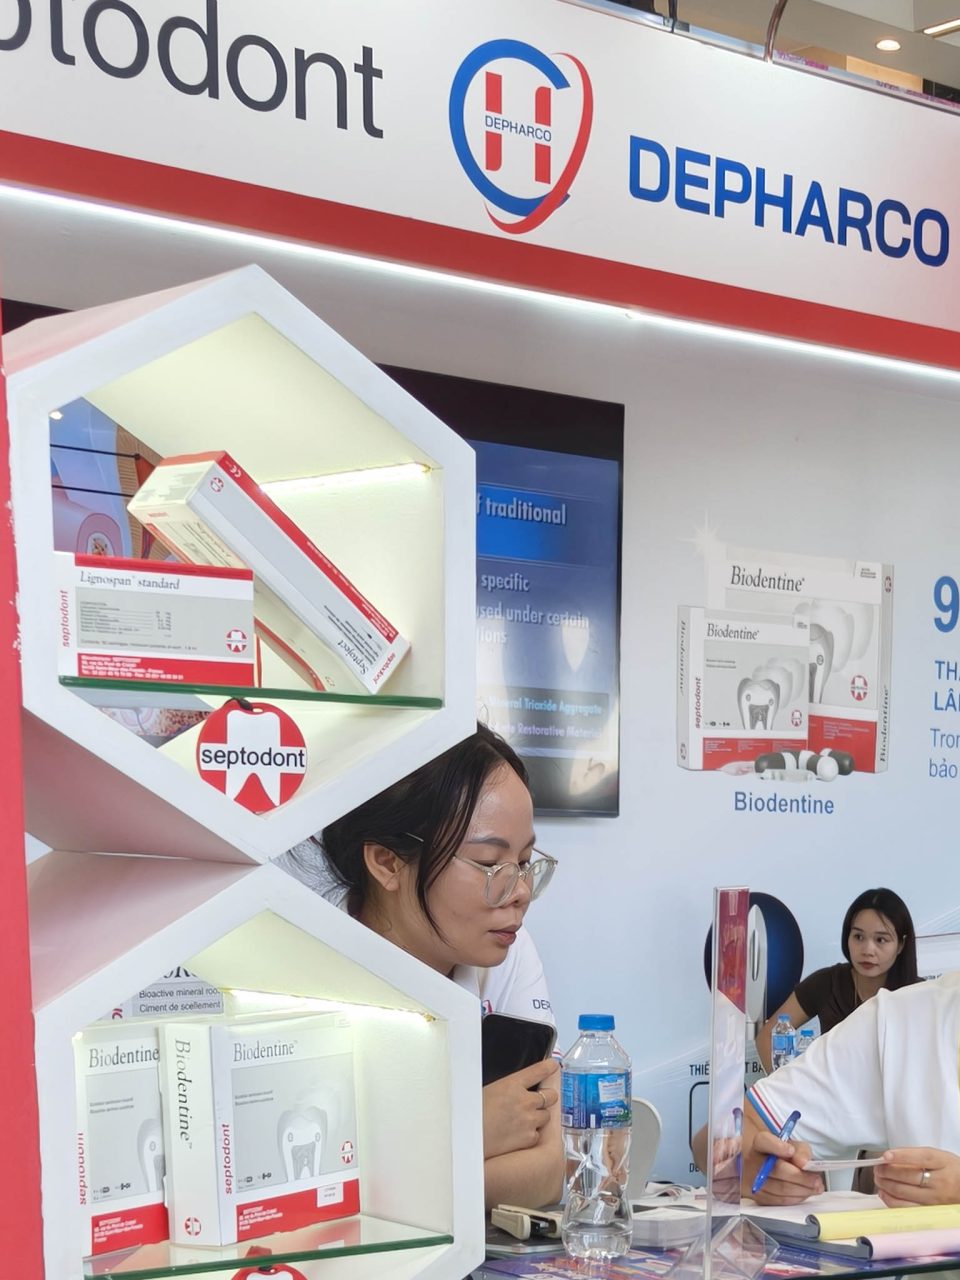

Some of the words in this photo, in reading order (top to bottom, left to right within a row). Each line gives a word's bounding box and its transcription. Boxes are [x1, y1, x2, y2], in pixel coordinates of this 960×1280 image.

[485, 115, 552, 142] DEPHARCO
[629, 135, 950, 267] DEPHARCO
[487, 497, 567, 525] traditional
[80, 571, 132, 588] Lignospan
[138, 577, 181, 590] standard
[481, 573, 530, 591] specific
[730, 565, 803, 592] Biodentine
[60, 590, 70, 648] septodont
[507, 604, 543, 624] under
[547, 610, 590, 629] certain
[707, 623, 757, 641] Biodentine
[338, 640, 368, 676] Septoject
[201, 744, 305, 772] septodont
[929, 758, 958, 779] bảo
[734, 791, 834, 815] Biodentine
[139, 989, 174, 999] Bioactive
[176, 987, 204, 996] mineral
[140, 1003, 167, 1013] Ciment
[169, 1003, 179, 1011] de
[88, 1045, 160, 1069] Biodentine
[233, 1039, 295, 1063] Biodentine
[222, 1123, 233, 1195] septodont
